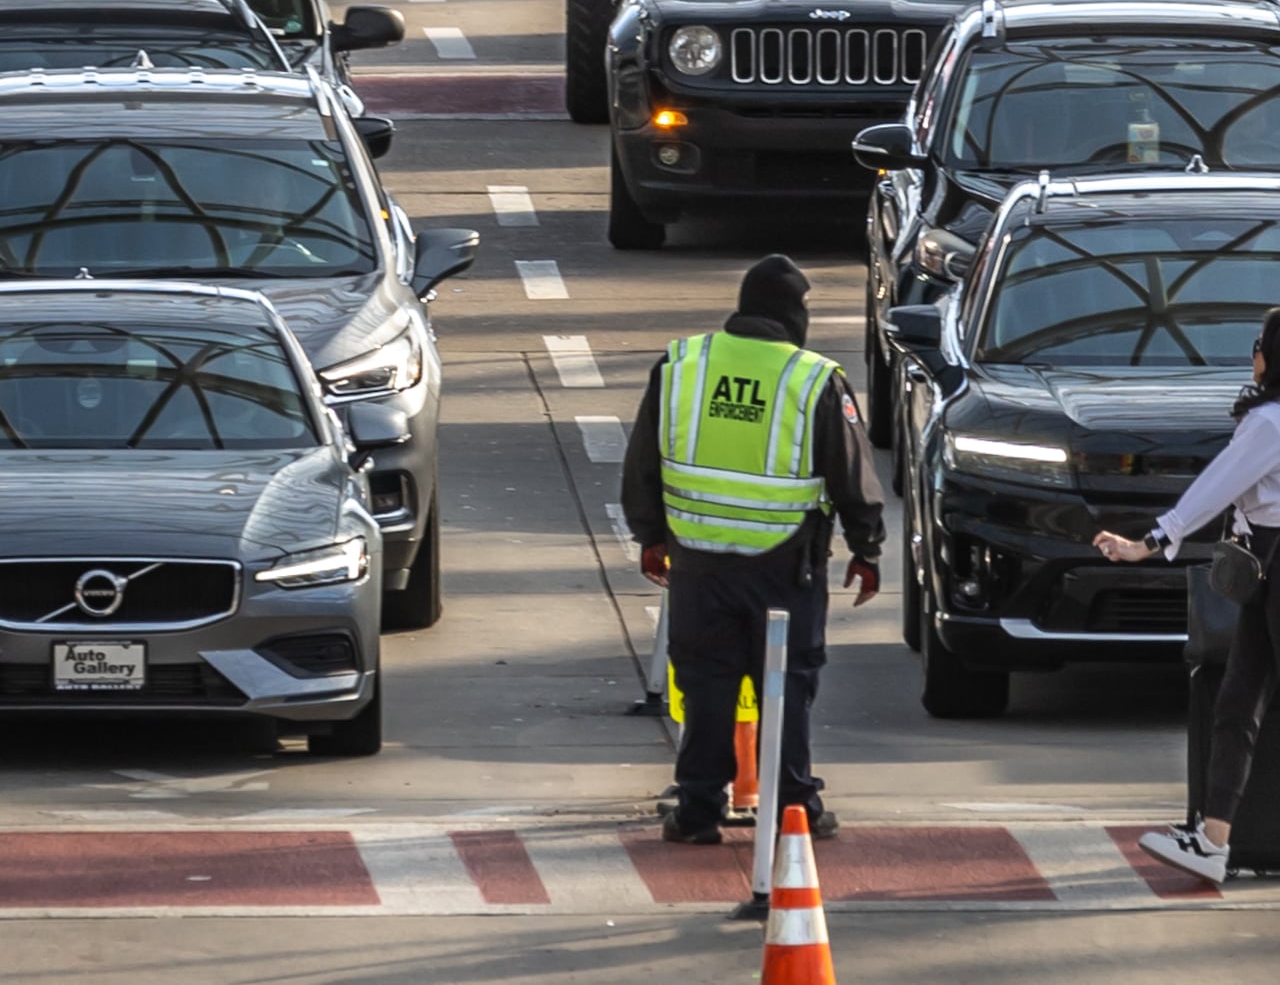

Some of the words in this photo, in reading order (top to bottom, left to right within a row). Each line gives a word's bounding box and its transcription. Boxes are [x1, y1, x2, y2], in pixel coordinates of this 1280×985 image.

[809, 8, 851, 21] Jeep
[712, 375, 766, 407] ATL
[65, 645, 106, 662] Auto
[73, 662, 136, 676] Gallery
